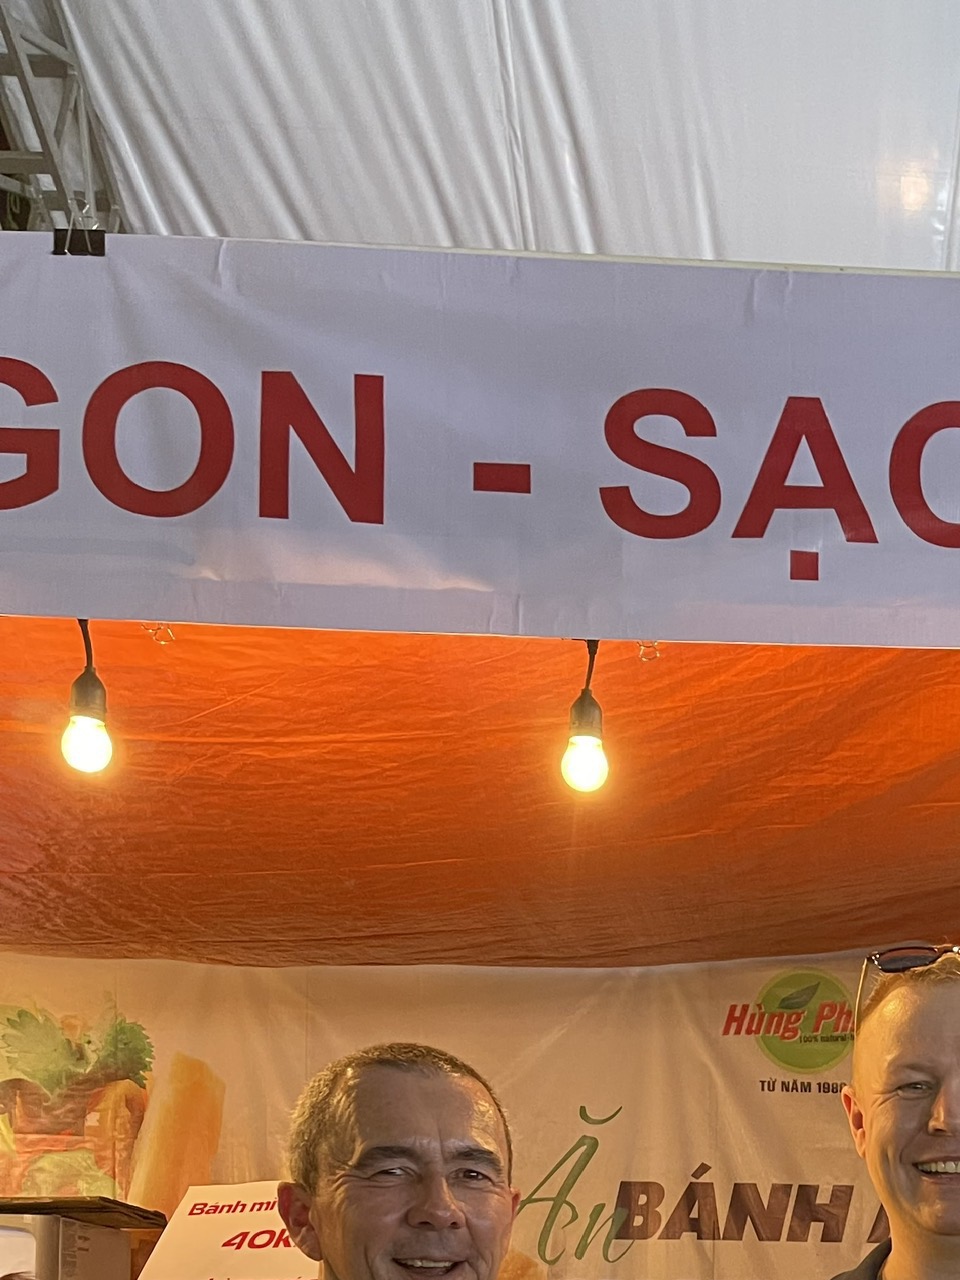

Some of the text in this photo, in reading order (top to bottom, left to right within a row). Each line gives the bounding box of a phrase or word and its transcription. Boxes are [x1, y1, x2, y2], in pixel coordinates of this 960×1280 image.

[722, 1003, 808, 1041] Hùng
[759, 1077, 777, 1092] TỪ
[780, 1078, 812, 1093] NĂM
[517, 1106, 854, 1265] Ăn BÁNH
[187, 1200, 247, 1216] Bánh
